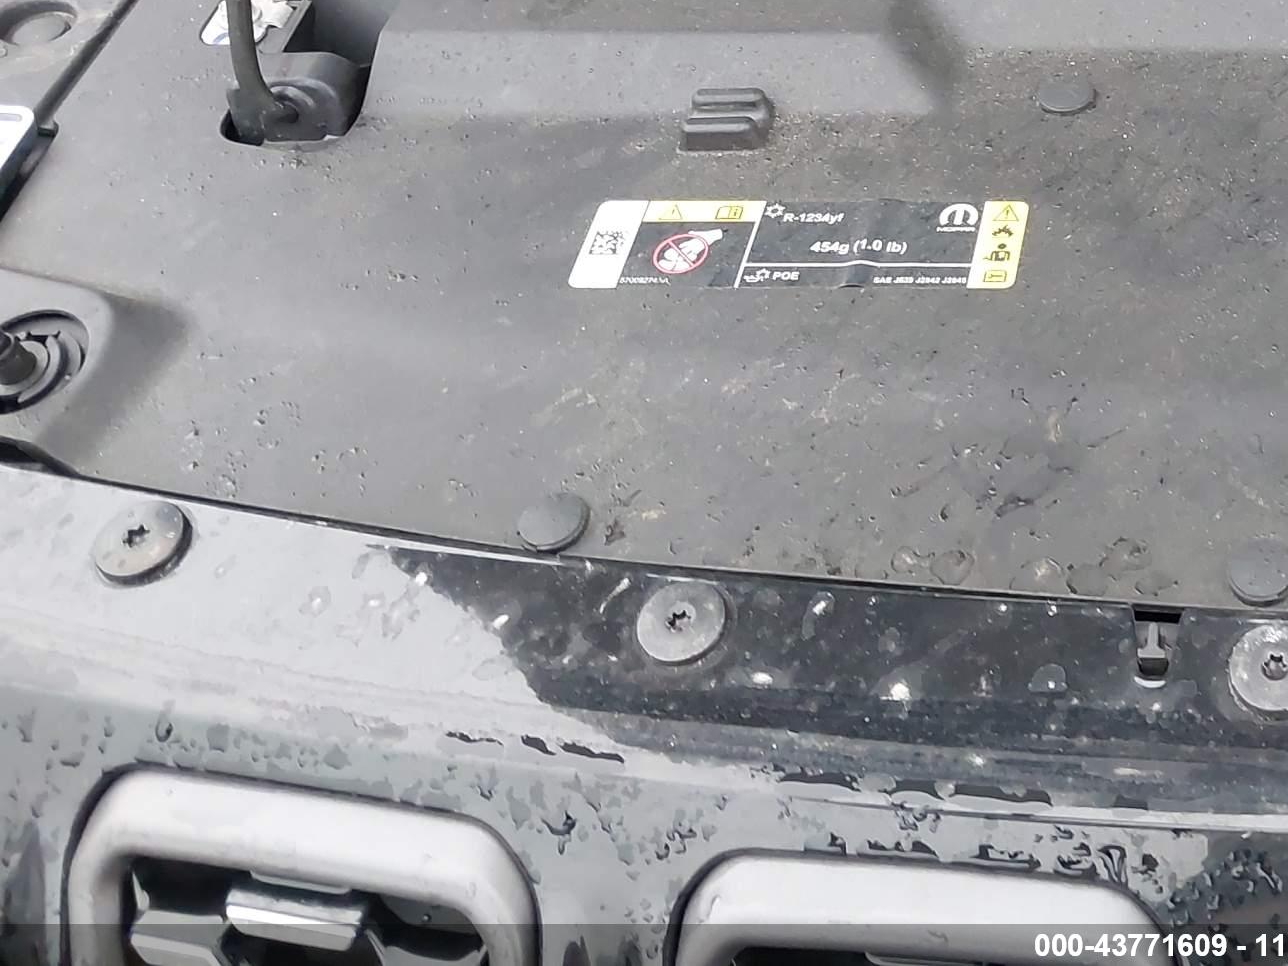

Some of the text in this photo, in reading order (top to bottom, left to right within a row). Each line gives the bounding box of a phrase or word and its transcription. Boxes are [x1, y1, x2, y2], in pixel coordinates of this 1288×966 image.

[783, 212, 844, 226] R-1234yf
[809, 238, 908, 254] 454g (1.0 lb)
[772, 270, 799, 282] POE
